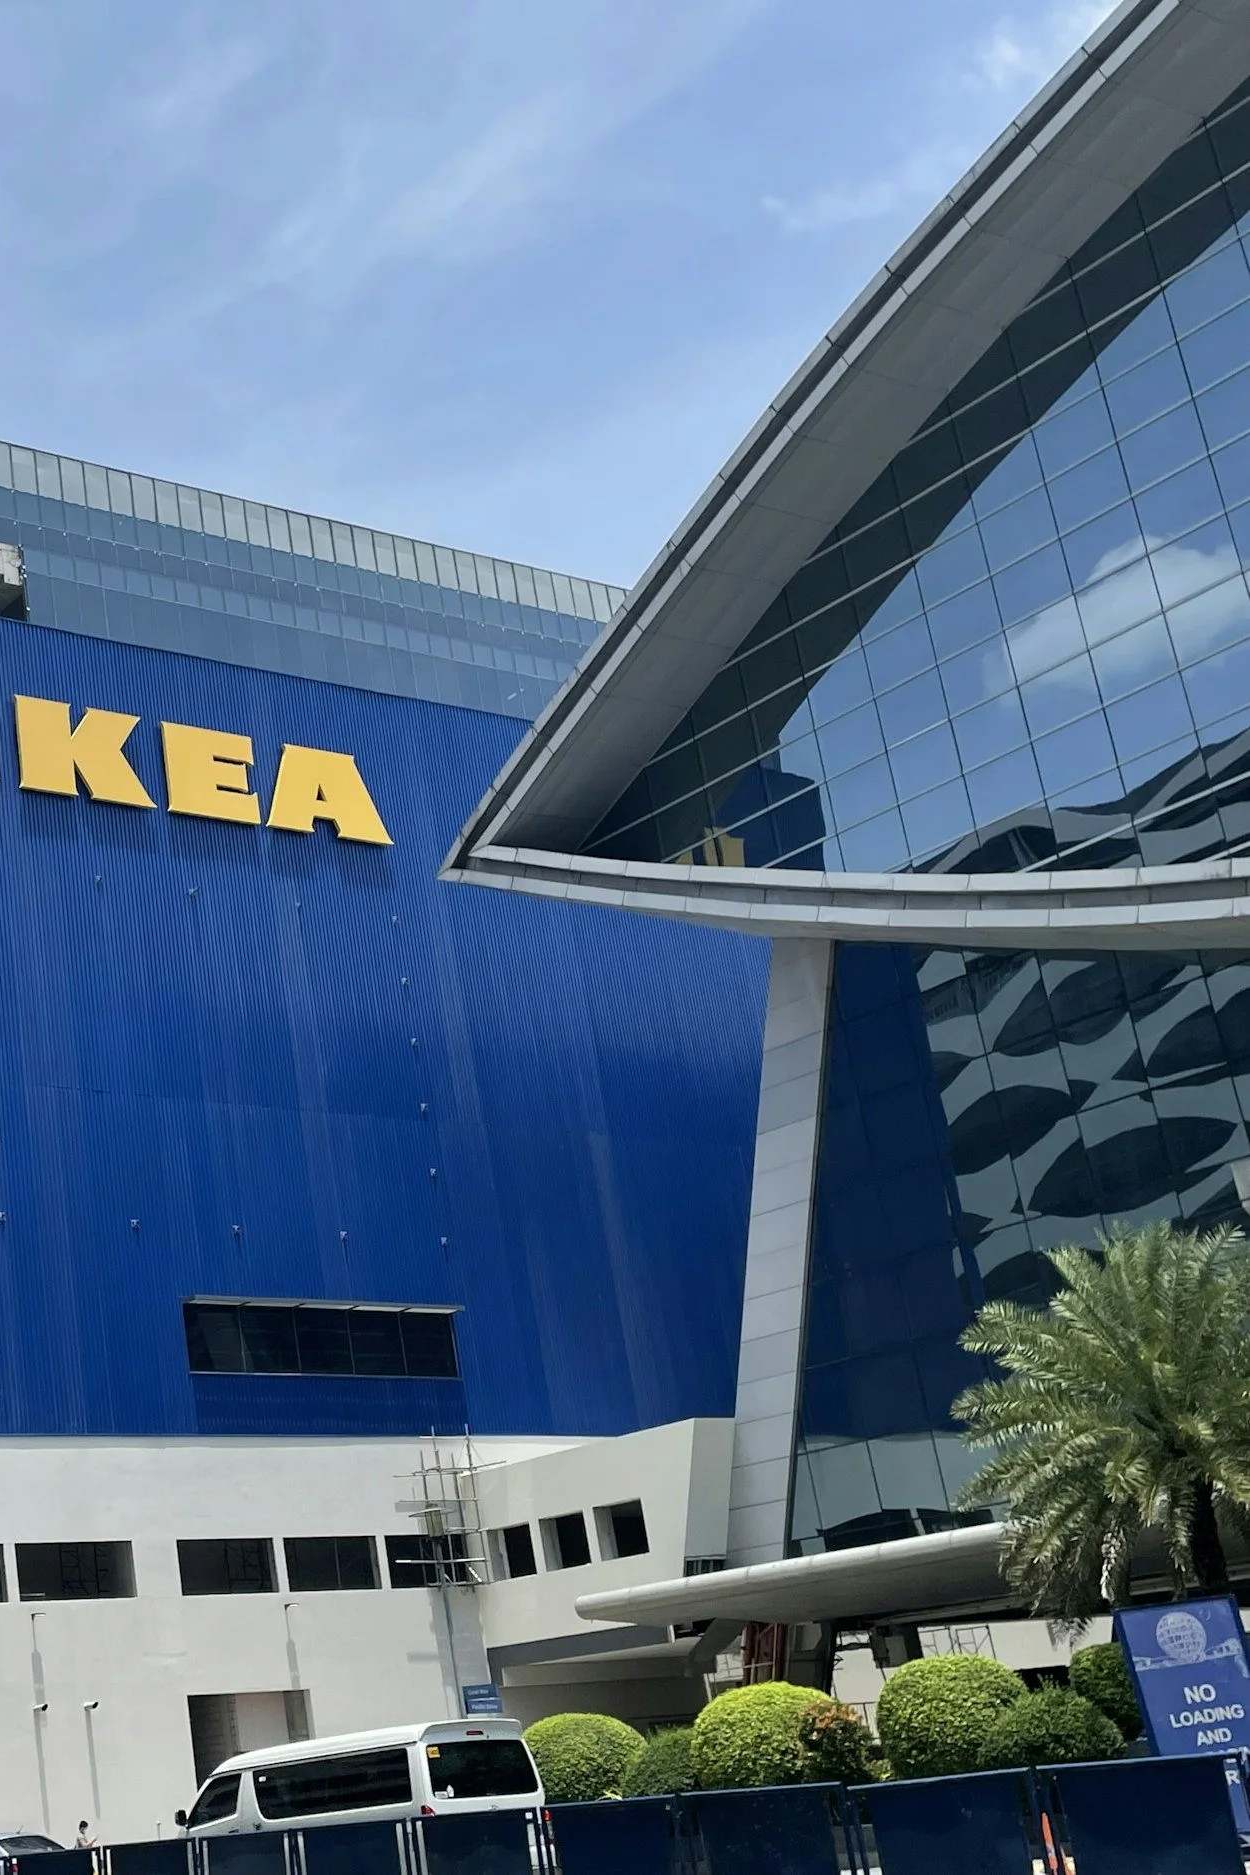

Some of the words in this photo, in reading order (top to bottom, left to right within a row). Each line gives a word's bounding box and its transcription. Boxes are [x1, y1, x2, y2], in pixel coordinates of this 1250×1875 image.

[1183, 1684, 1216, 1704] NO
[1169, 1704, 1244, 1728] LOADING
[1197, 1728, 1232, 1746] AND
